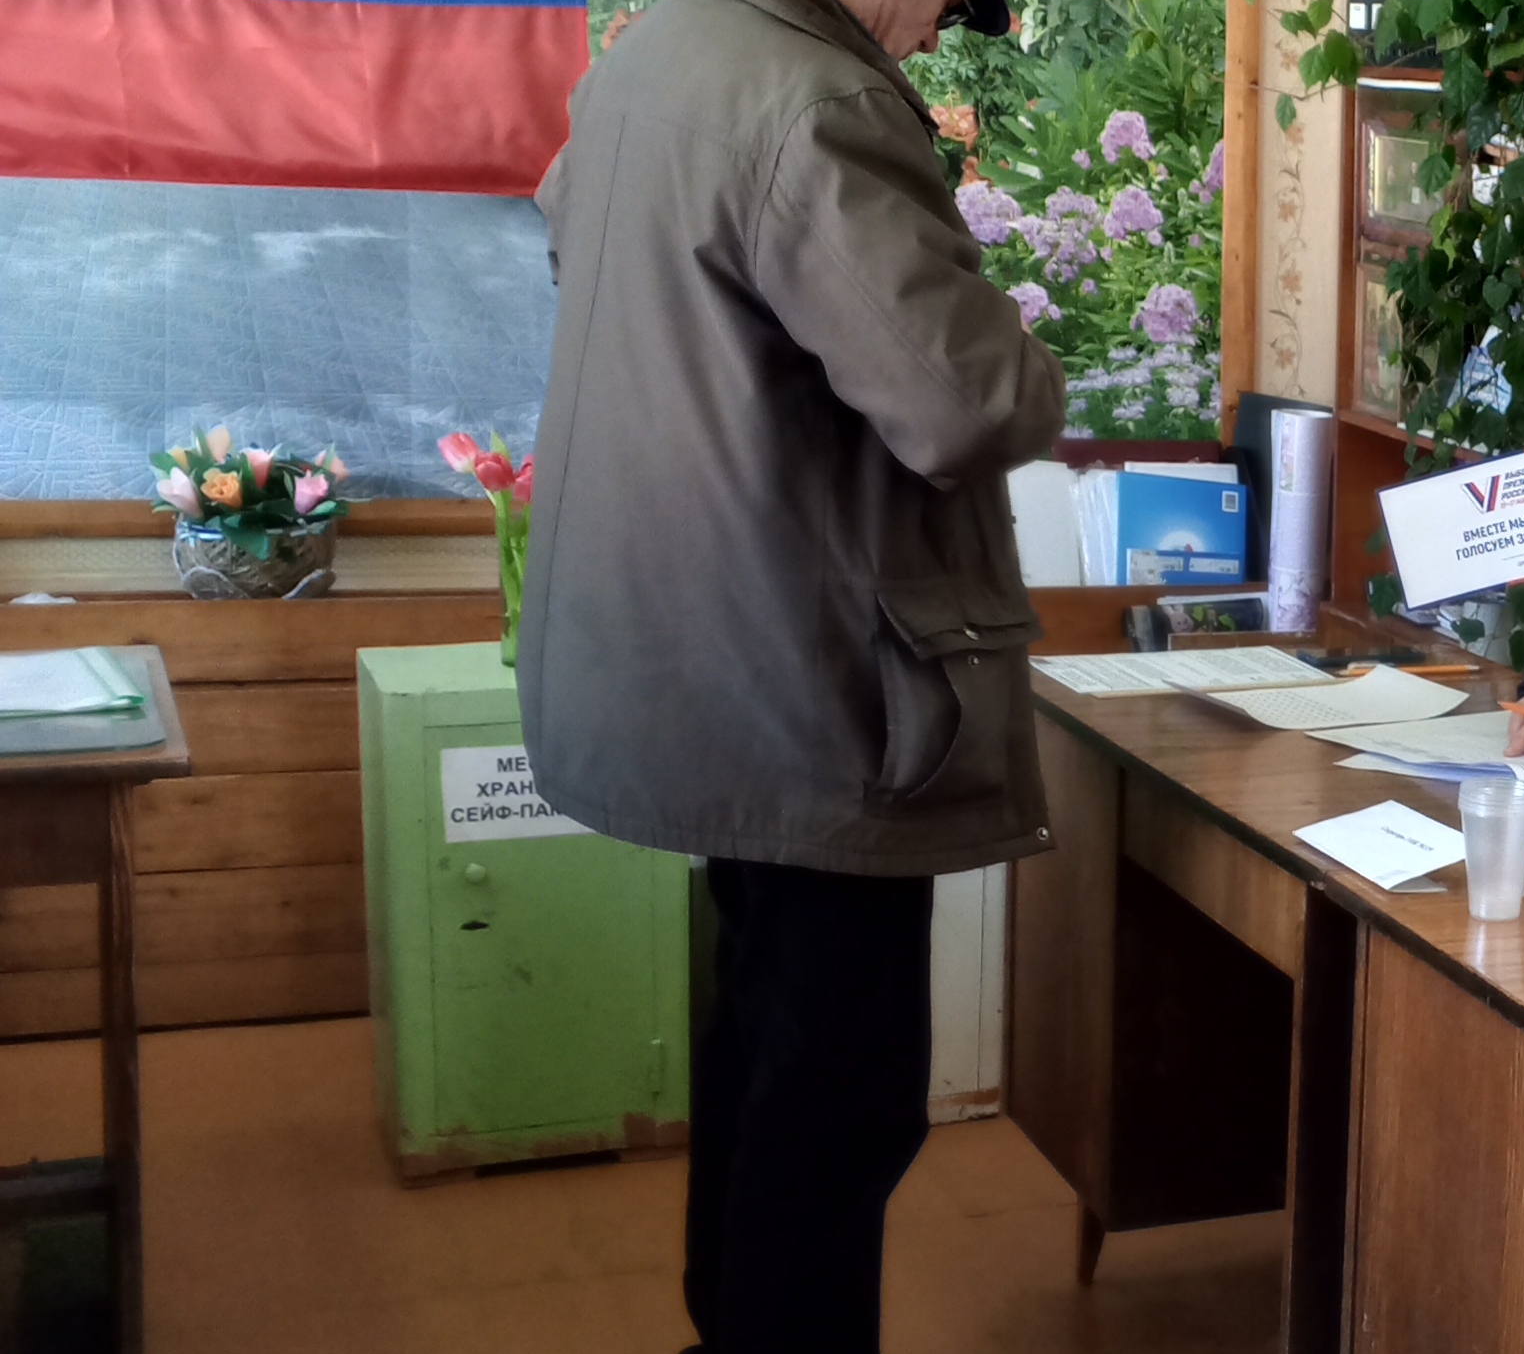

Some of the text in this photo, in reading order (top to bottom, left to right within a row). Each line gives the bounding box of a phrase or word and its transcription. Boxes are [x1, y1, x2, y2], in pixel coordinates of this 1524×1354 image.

[1463, 520, 1507, 542] ВМЕСТЕ
[1456, 537, 1515, 560] ГОЛОСУЕМ
[476, 779, 537, 798] ХРАН
